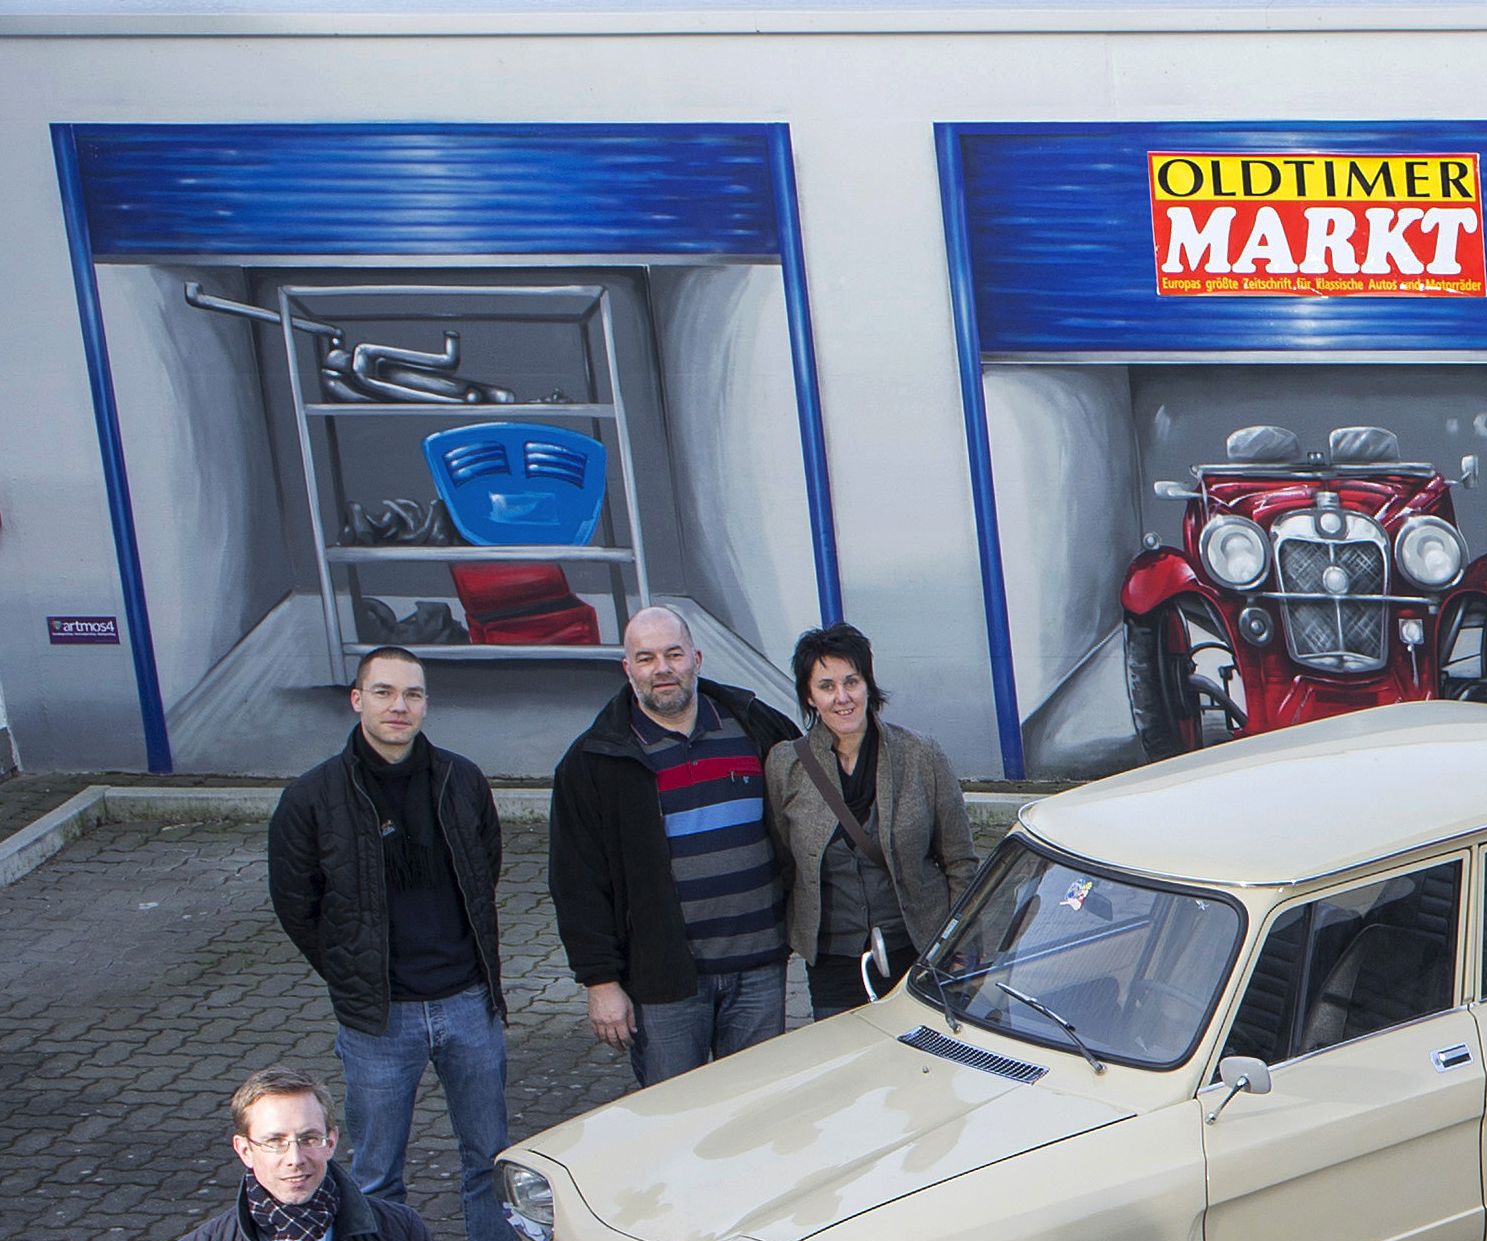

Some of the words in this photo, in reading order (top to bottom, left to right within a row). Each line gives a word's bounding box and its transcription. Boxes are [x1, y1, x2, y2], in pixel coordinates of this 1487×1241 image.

[1157, 159, 1473, 198] OLDTIMER
[1161, 206, 1478, 274] MARKT
[1162, 277, 1201, 291] Europas
[1205, 277, 1239, 292] größte
[1243, 277, 1292, 289] Zeitschrift
[1296, 278, 1311, 290] für
[1368, 279, 1397, 290] Autos
[1425, 278, 1482, 291] Motorräder
[63, 620, 115, 632] artmos4
